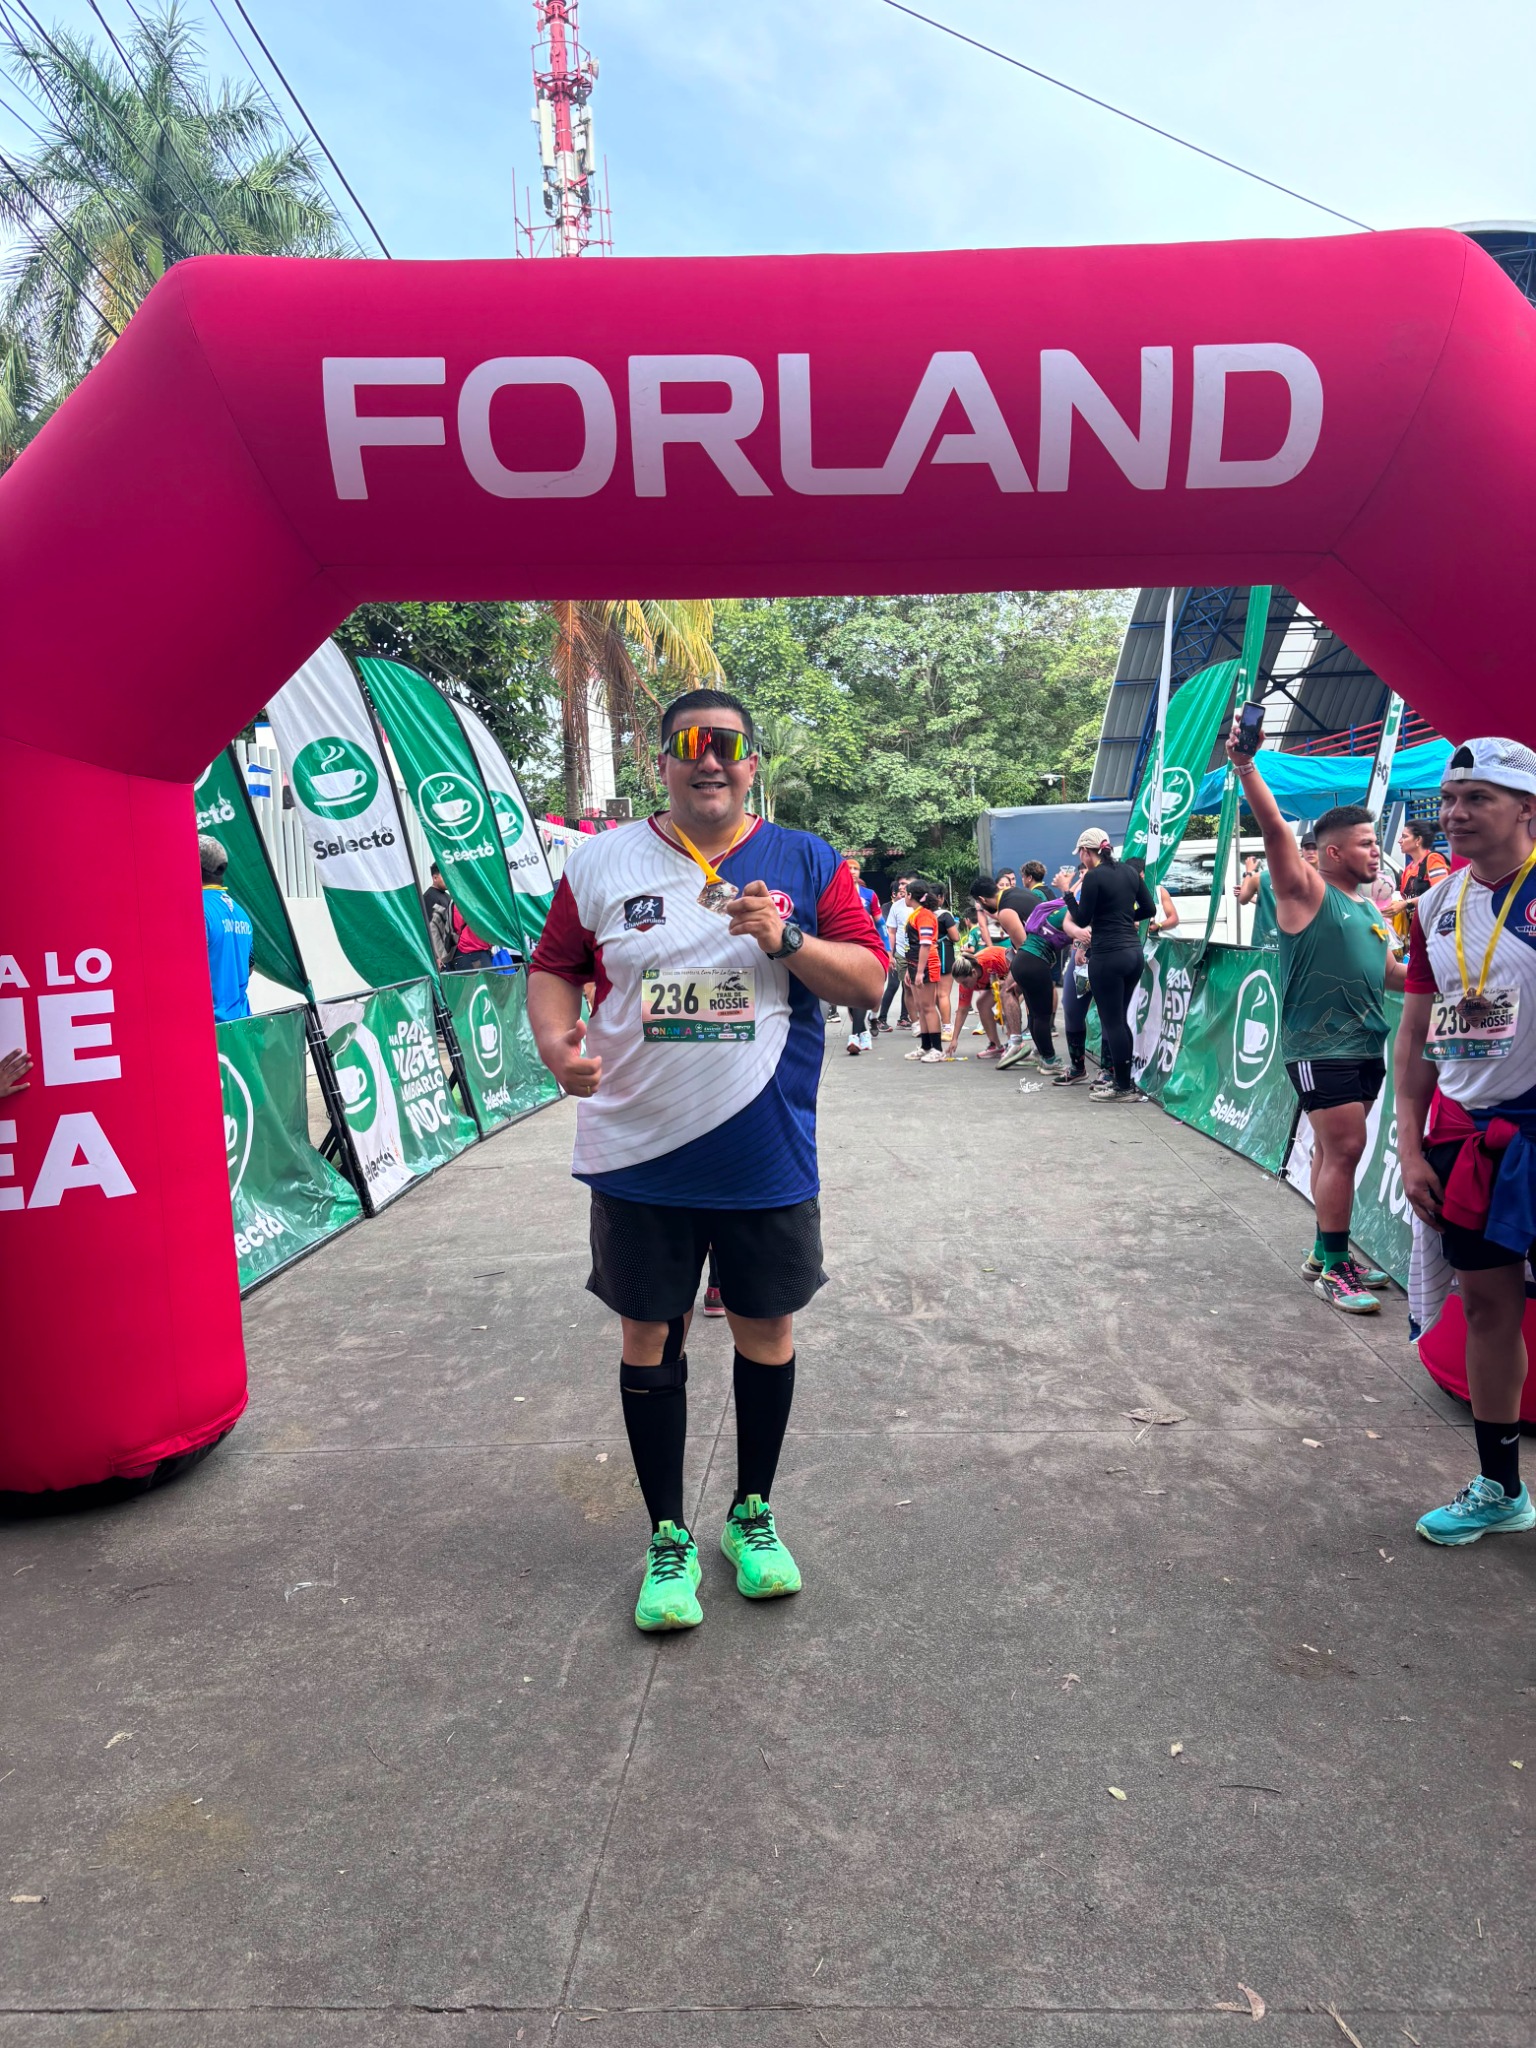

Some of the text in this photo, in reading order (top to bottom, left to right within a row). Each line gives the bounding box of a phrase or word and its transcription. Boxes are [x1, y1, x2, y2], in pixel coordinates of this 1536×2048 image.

[322, 343, 1324, 501] FORLAND
[313, 828, 396, 860] Selecto
[44, 947, 113, 986] LO
[650, 983, 699, 1015] 236
[710, 997, 749, 1011] ROSSIE
[1481, 1014, 1514, 1029] ROSSIE
[1210, 1094, 1250, 1131] Selecto
